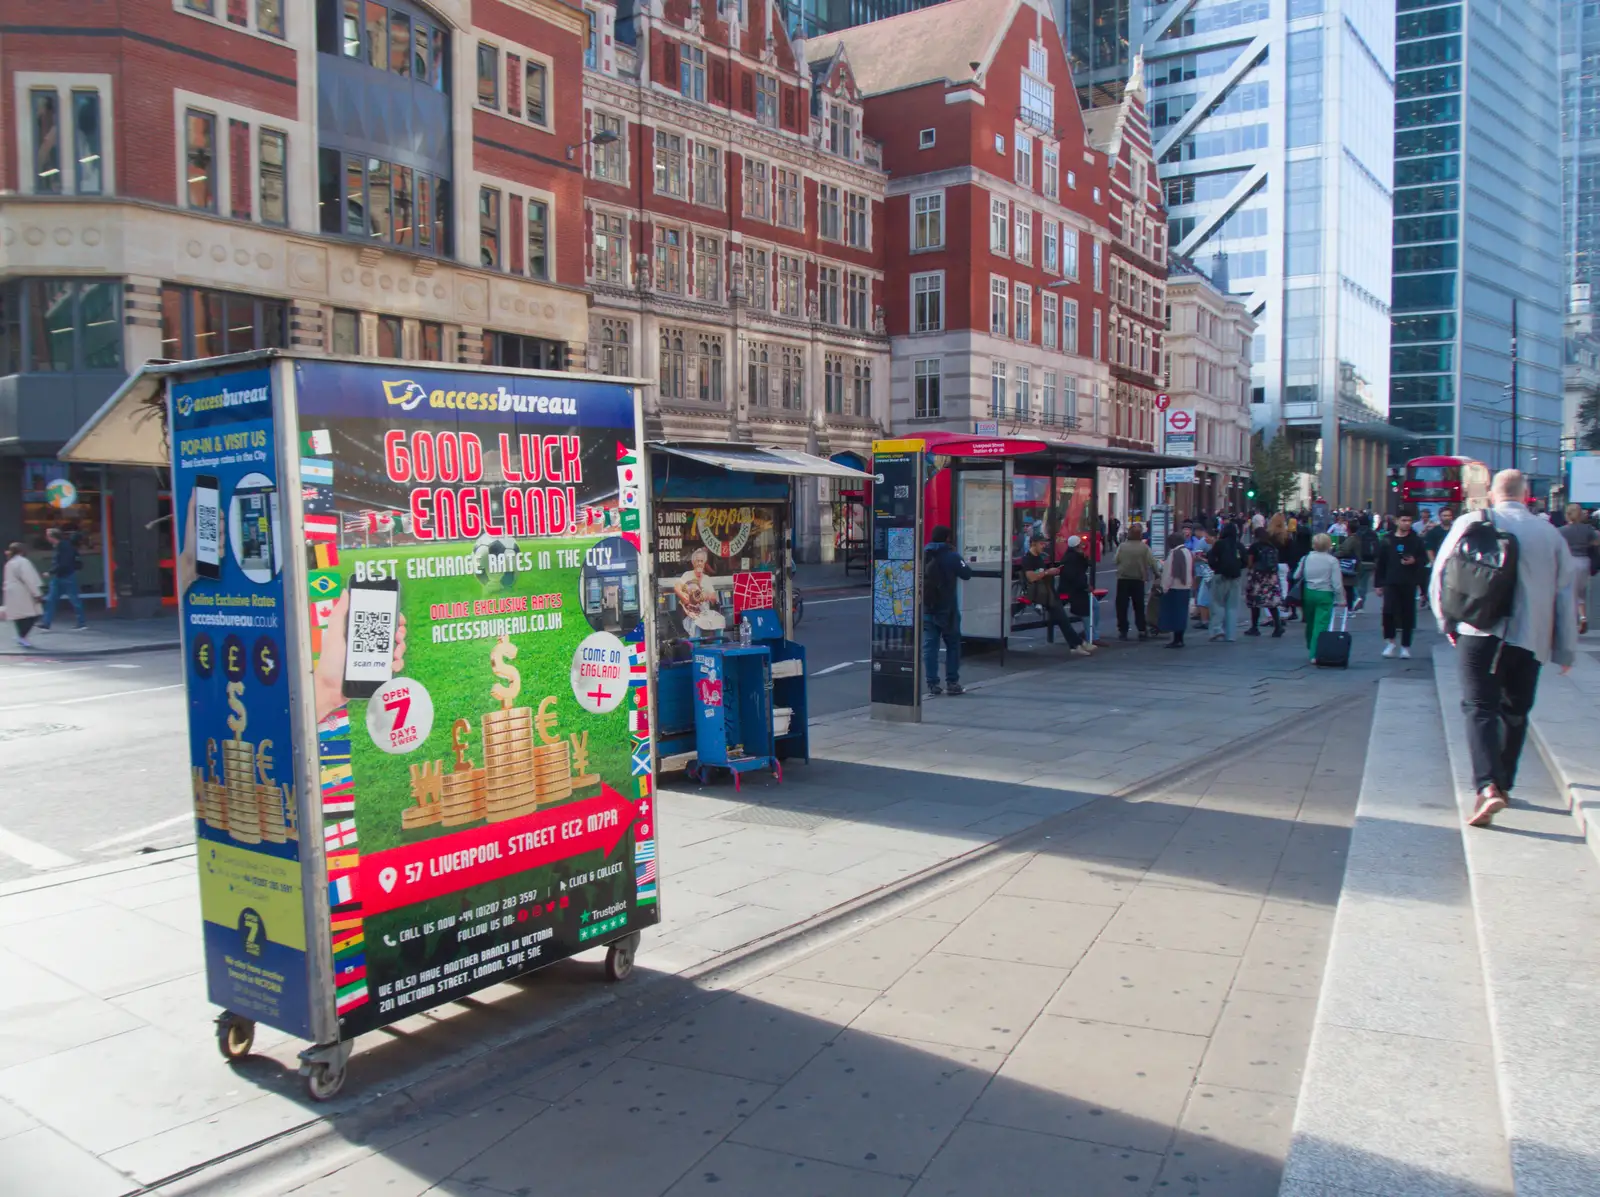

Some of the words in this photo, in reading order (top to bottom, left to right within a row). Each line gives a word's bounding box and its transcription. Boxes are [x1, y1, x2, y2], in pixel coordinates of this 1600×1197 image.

[193, 387, 268, 412] accessbureau
[429, 386, 577, 415] accessbureau
[1158, 395, 1167, 408] F
[181, 436, 213, 456] POP-IN
[214, 436, 222, 452] &
[223, 431, 249, 450] VISIT
[251, 429, 266, 448] US
[253, 450, 266, 462] City
[384, 429, 484, 483] GOOD
[499, 432, 583, 483] LUCK
[410, 486, 578, 541] ENGLAND!
[657, 513, 663, 524] 5
[665, 512, 687, 524] MINS
[658, 525, 682, 537] WALK
[702, 527, 721, 553] FISH
[730, 524, 749, 554] CHIPS
[658, 538, 683, 550] FROM
[355, 559, 399, 582] BEST
[406, 554, 482, 579] EXCHANGE
[488, 551, 533, 573] RATES
[538, 550, 550, 570] IN
[556, 548, 581, 568] THE
[586, 547, 612, 566] CITY
[658, 551, 681, 563] HERE
[189, 593, 214, 606] Online
[251, 594, 276, 607] Rates
[430, 601, 469, 620] ONLINE
[474, 598, 527, 616] EXCLUSIVE
[532, 593, 562, 609] RATES
[190, 611, 278, 628] accessbureau.co.uk
[432, 612, 562, 644] ACCESSBUREAU.CO.UK
[583, 647, 606, 662] COME
[610, 650, 620, 663] ON
[580, 663, 620, 679] ENGLAND!
[382, 687, 410, 702] OPEN
[384, 696, 411, 731] 7
[389, 725, 416, 741] DAYS
[391, 740, 397, 748] A
[397, 735, 418, 746] WEEK
[404, 862, 424, 884] 57
[429, 841, 503, 877] LIVERPOOL
[507, 825, 557, 856] STREET
[561, 818, 583, 841] EC2
[587, 808, 618, 833] M7PR
[568, 873, 588, 888] CLICK
[589, 871, 595, 881] &
[596, 862, 623, 879] COLLECT
[400, 926, 421, 942] CALL
[423, 922, 435, 935] US
[437, 916, 456, 930] NOW
[458, 909, 473, 922] +44
[475, 901, 499, 918] (0)207
[502, 896, 517, 910] 283
[519, 890, 538, 904] 3597
[591, 900, 627, 920] Trustpilot
[457, 922, 488, 942] FOLLOW
[490, 918, 500, 931] US
[502, 914, 515, 927] ON:
[378, 983, 393, 997] WE
[394, 975, 417, 992] ALSO
[420, 966, 441, 983] HAVE
[443, 954, 479, 975] ANOTHER
[481, 942, 510, 961] BRANCH
[512, 939, 520, 951] IN
[521, 927, 554, 947] VICTORIA
[380, 999, 395, 1013] 201
[396, 983, 435, 1006] VICTORIA
[507, 951, 525, 967] SW1E
[527, 946, 541, 960] 5NE
